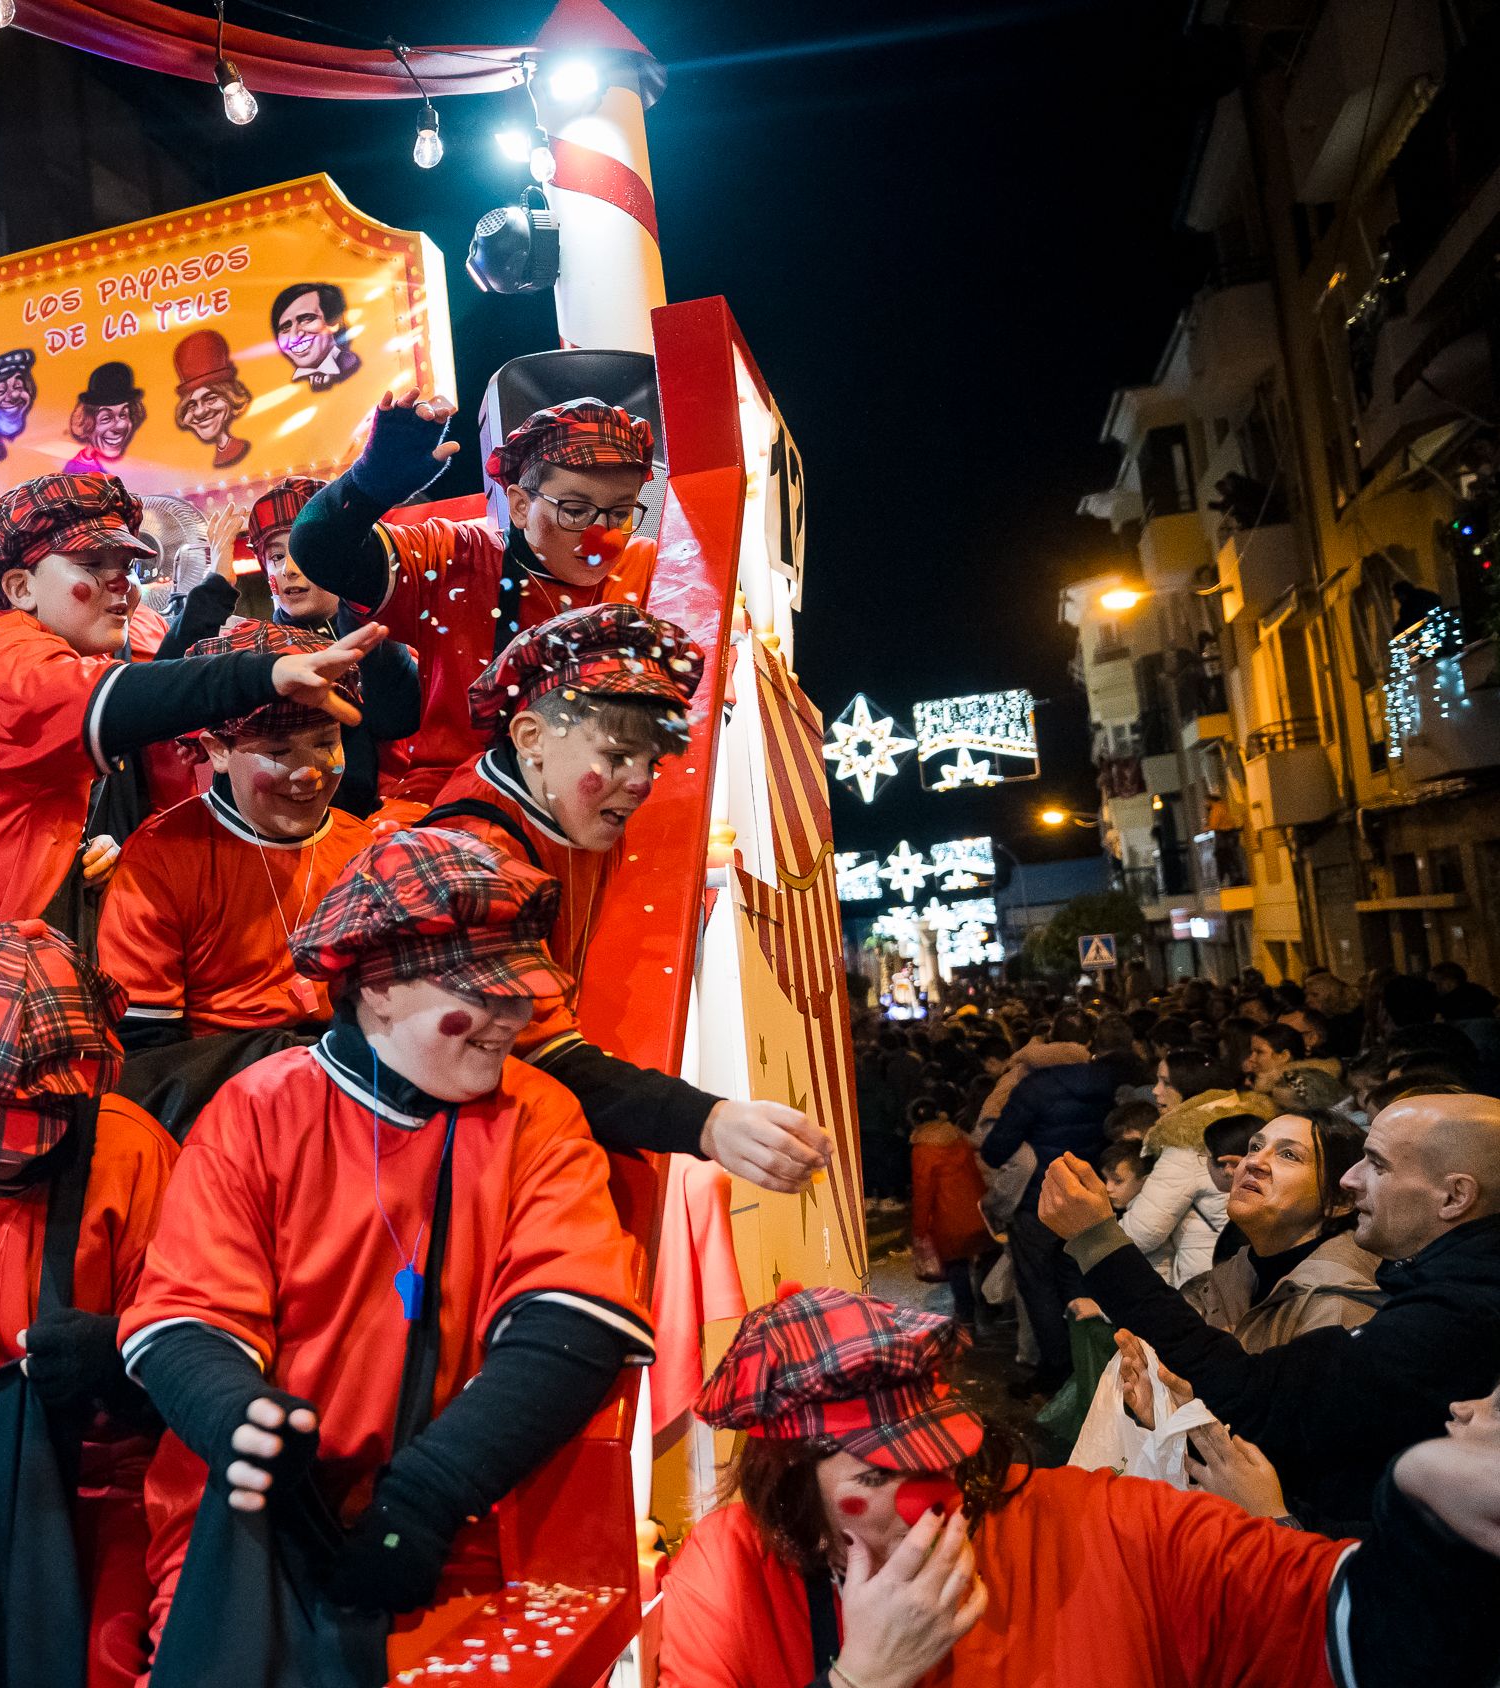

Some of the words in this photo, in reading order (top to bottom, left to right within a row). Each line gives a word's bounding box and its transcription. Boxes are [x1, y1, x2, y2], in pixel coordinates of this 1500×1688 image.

[22, 288, 82, 324] LOS
[97, 245, 250, 304] PAYASOS
[45, 324, 86, 355] DE
[103, 312, 139, 341] LA
[153, 288, 231, 331] TELE
